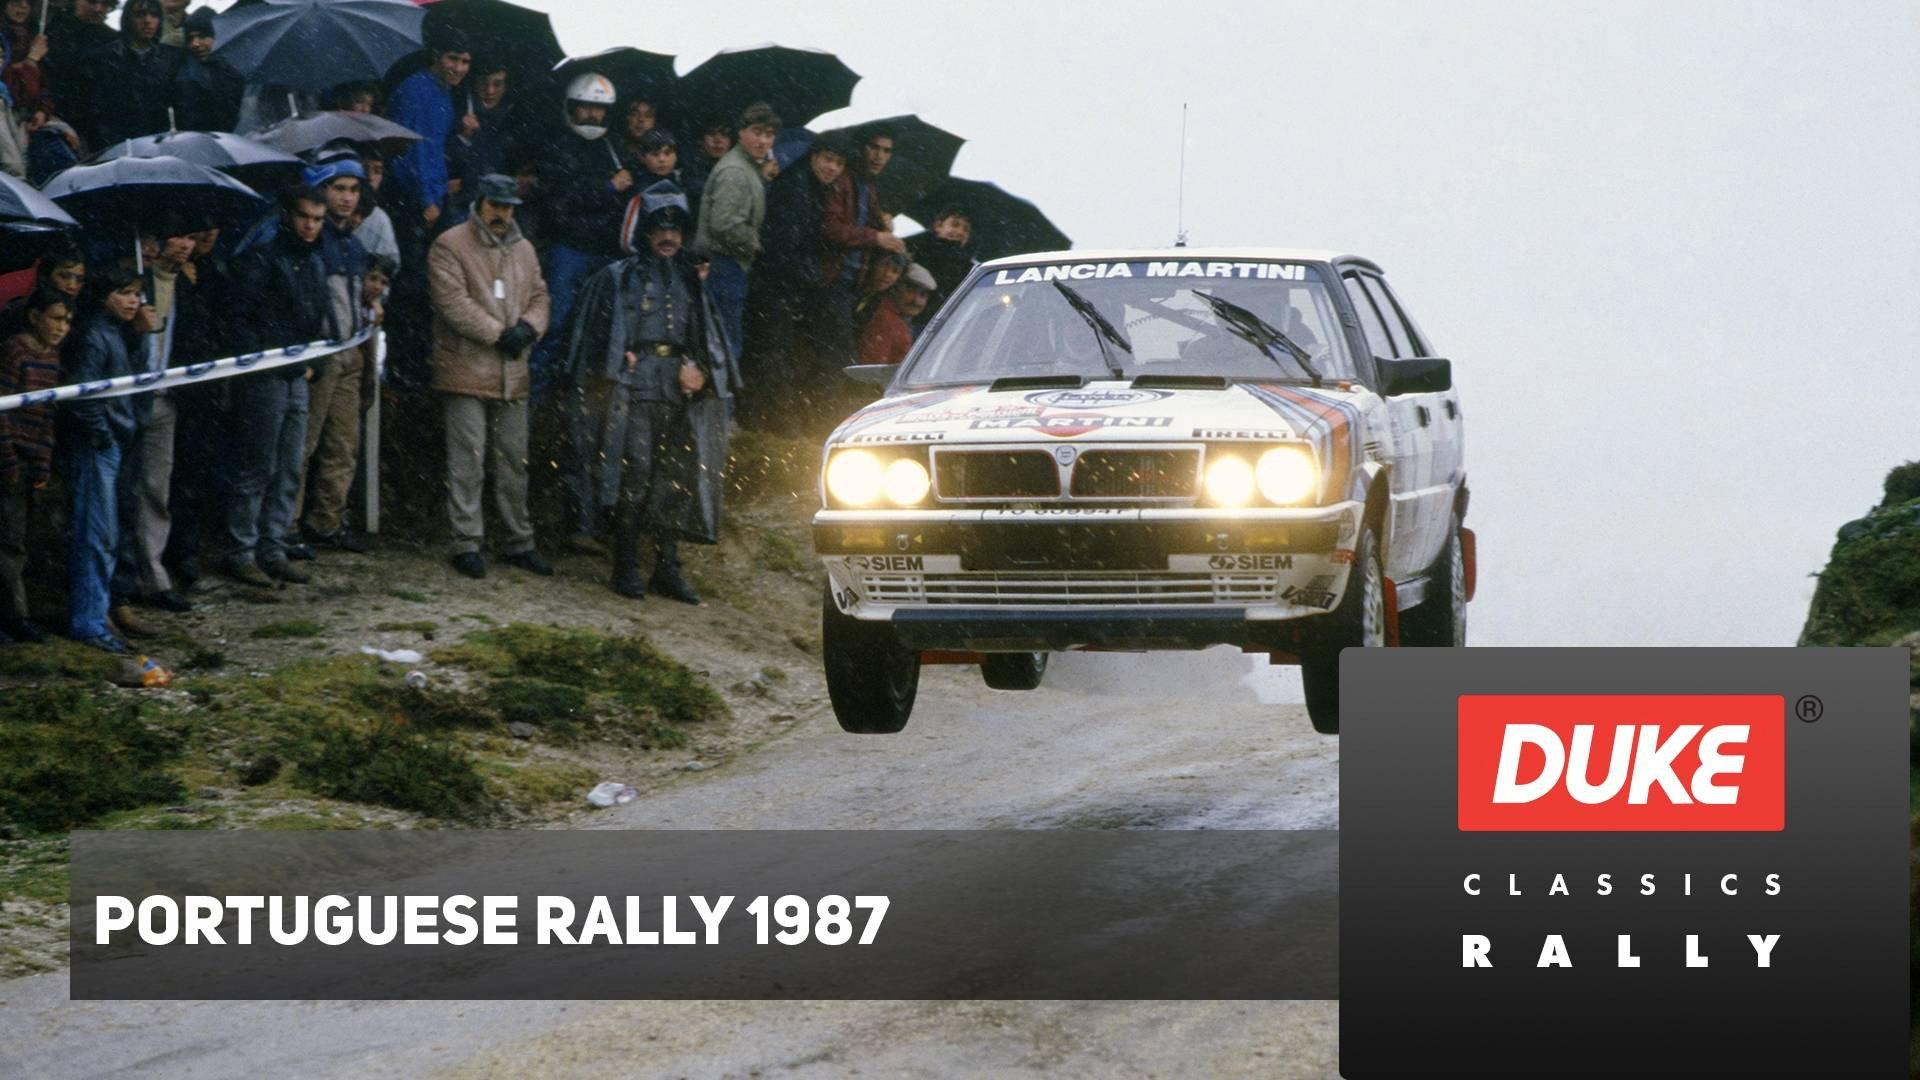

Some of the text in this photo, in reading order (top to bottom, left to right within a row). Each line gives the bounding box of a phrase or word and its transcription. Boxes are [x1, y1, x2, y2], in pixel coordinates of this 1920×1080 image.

[994, 262, 1306, 285] LANCIA MARTINI
[975, 416, 1168, 428] MARTINI
[872, 556, 924, 571] SIEM
[1237, 555, 1293, 570] SIEM
